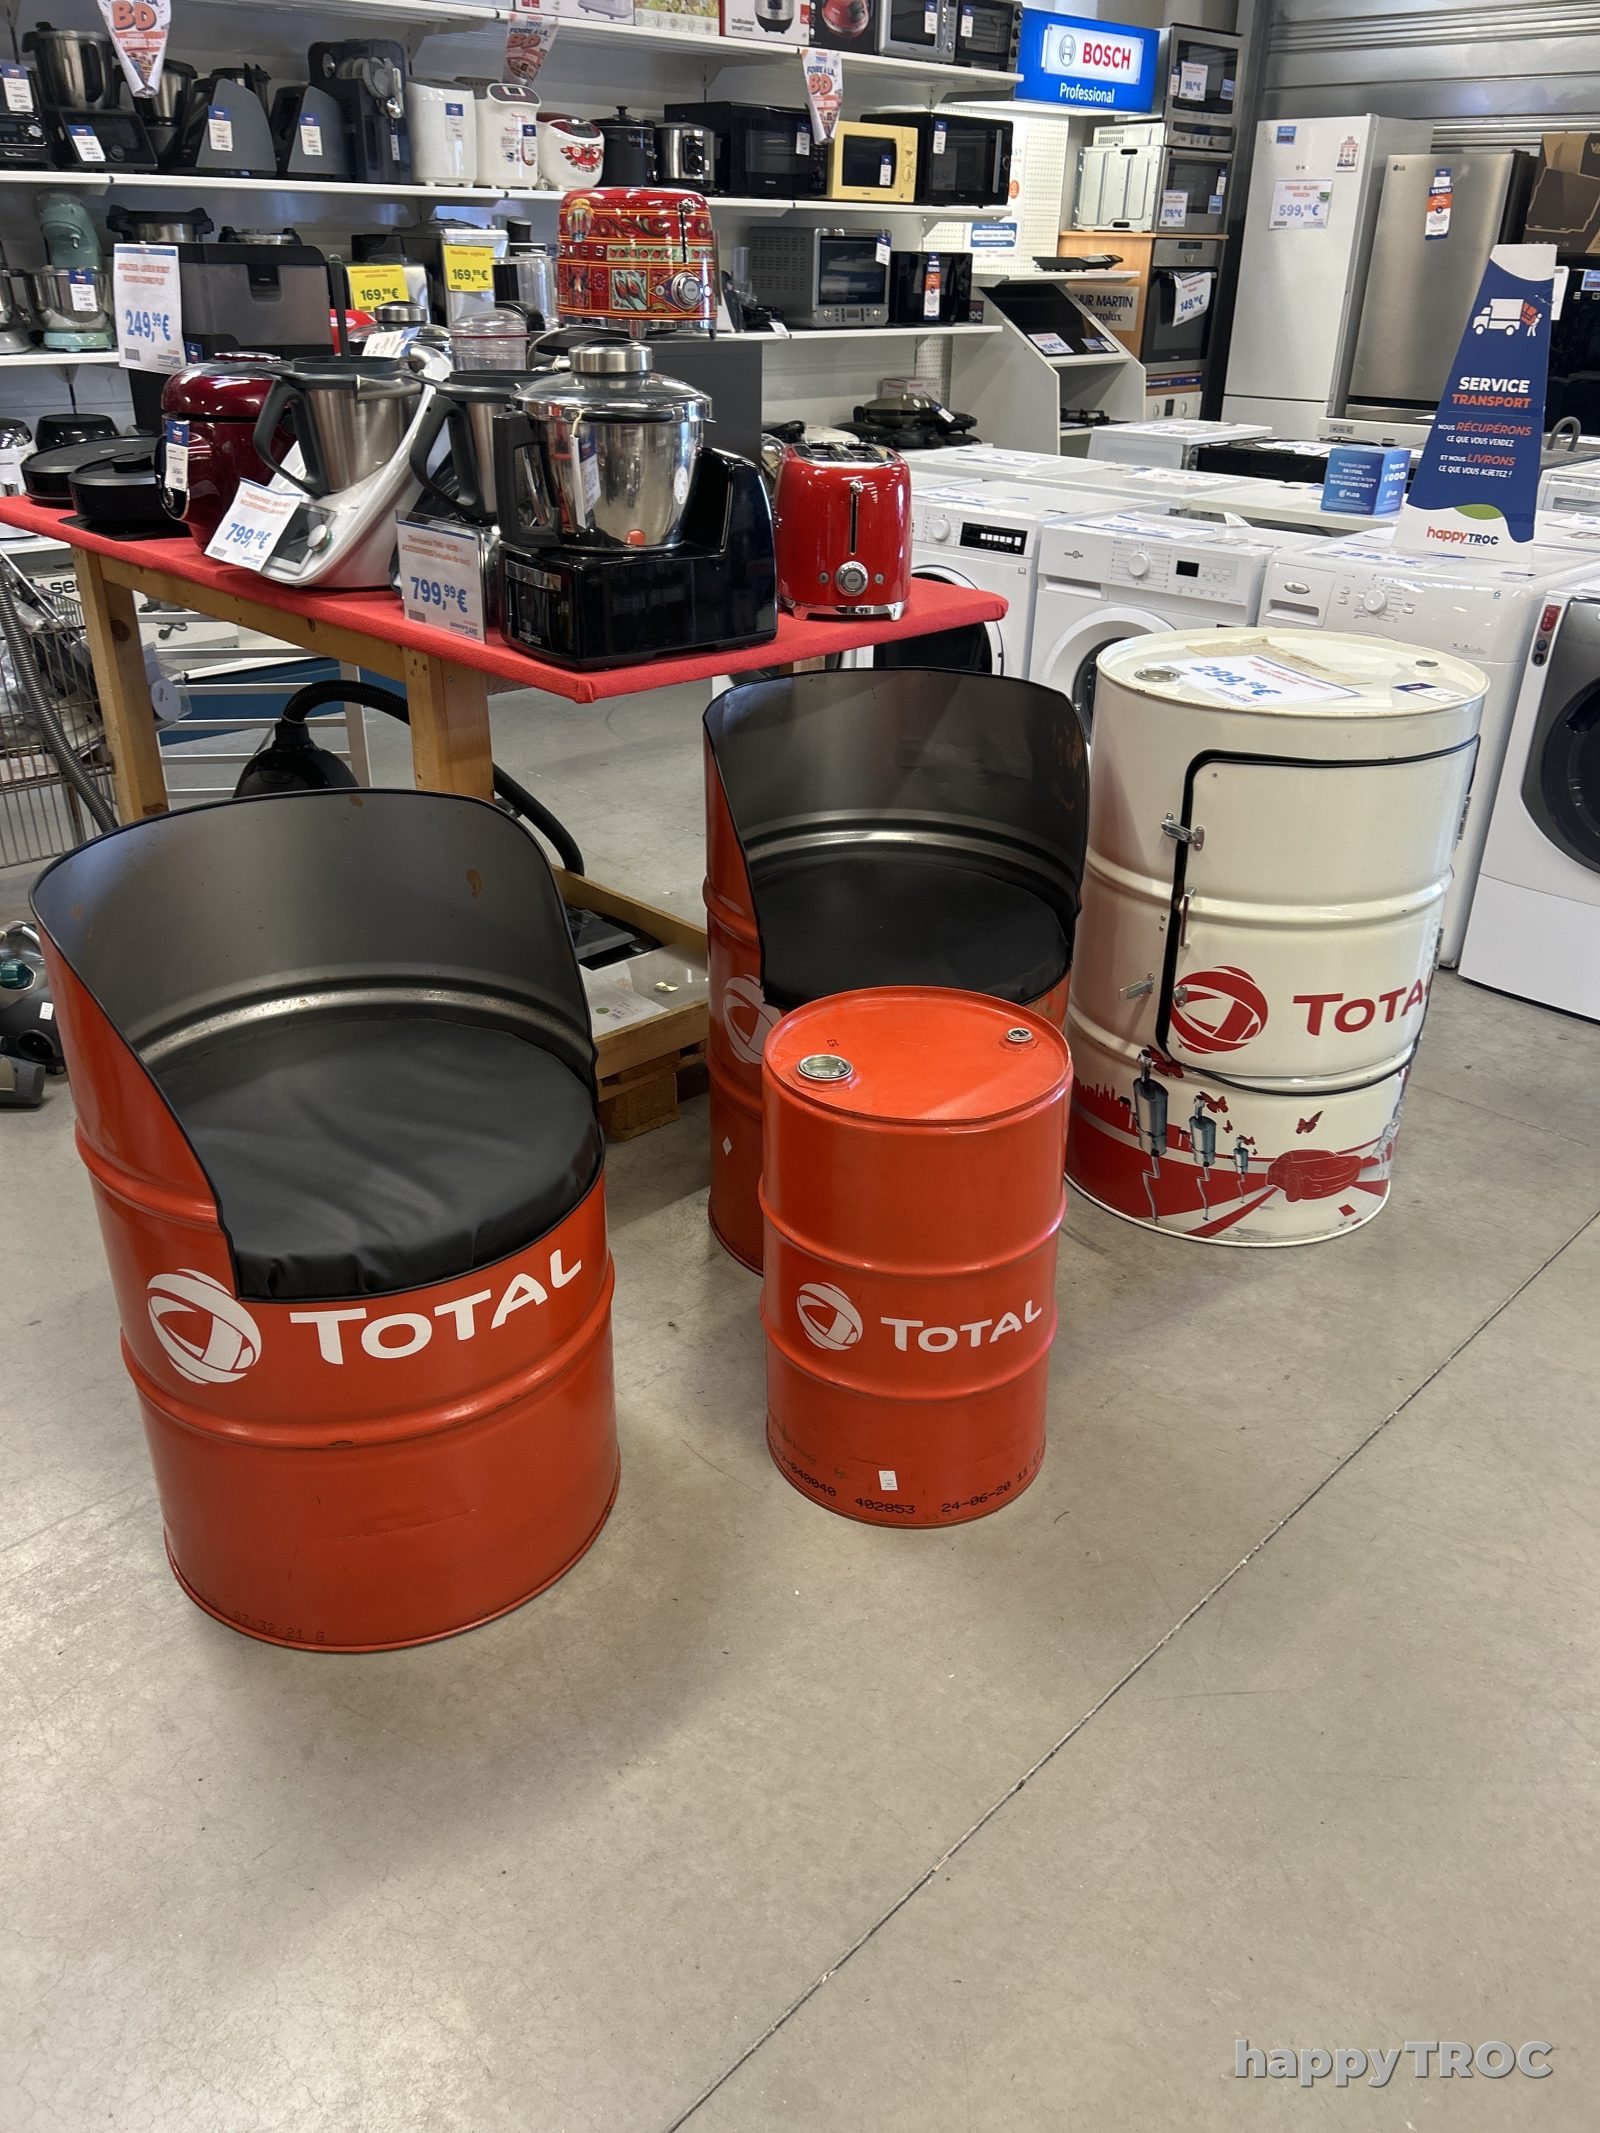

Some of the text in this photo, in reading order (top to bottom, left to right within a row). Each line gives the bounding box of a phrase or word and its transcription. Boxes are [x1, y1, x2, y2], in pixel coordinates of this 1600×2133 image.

[1082, 42, 1131, 70] BOSCH
[808, 73, 833, 95] BD
[1059, 82, 1115, 104] Professional
[1096, 294, 1133, 308] MARTIN
[1458, 376, 1531, 393] SERVICE
[1452, 394, 1531, 408] TRANSPORT
[1438, 420, 1533, 436] NOUS RÉCUPÉRONS
[1456, 436, 1469, 444] QUE
[1470, 437, 1488, 446] VOUS
[1489, 438, 1515, 448] VENDEZ
[1467, 454, 1516, 466] LIVRONS
[1438, 464, 1447, 472] CE
[1447, 466, 1461, 474] QUE
[1462, 466, 1479, 475] VOUS
[1480, 468, 1508, 478] ACHETEZ
[411, 576, 468, 613] 799,99€
[1292, 977, 1430, 1036] TOTA
[290, 1249, 582, 1365] TOTAL
[880, 1299, 1042, 1353] TOTAL
[855, 1497, 916, 1515] 402853
